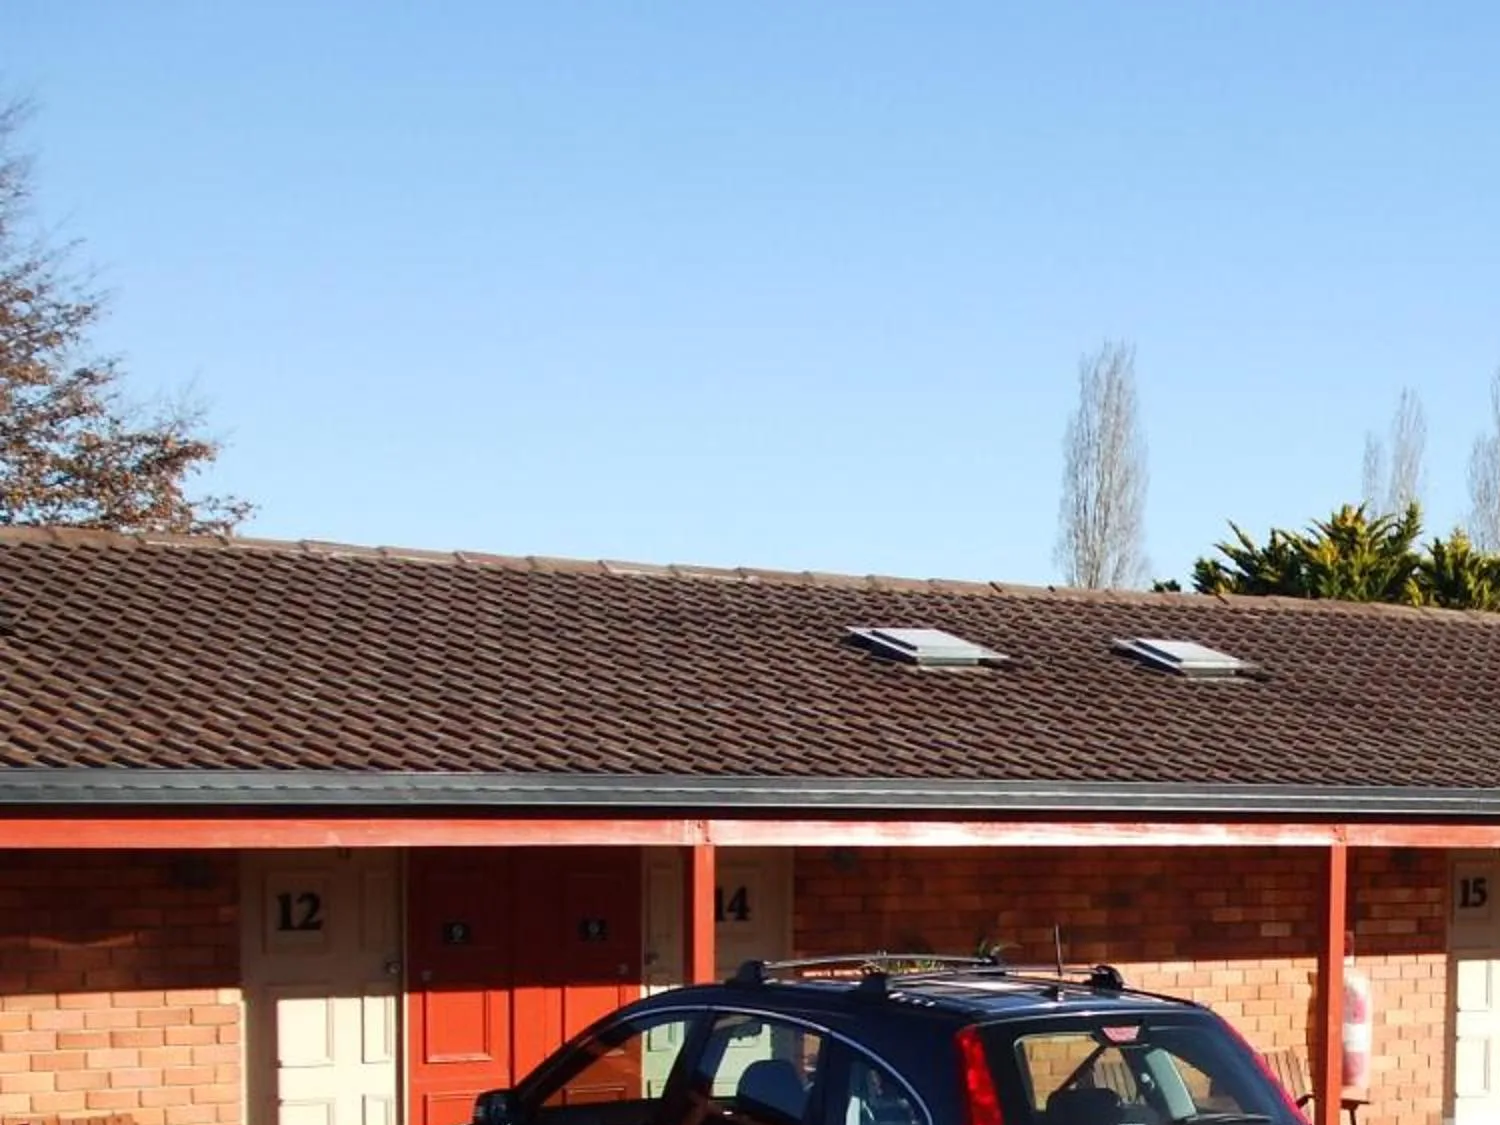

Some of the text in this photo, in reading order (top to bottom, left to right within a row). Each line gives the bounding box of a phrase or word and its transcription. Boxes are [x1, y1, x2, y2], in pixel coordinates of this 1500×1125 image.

[715, 886, 751, 922] 14
[1459, 877, 1488, 909] 15
[277, 892, 324, 931] 12
